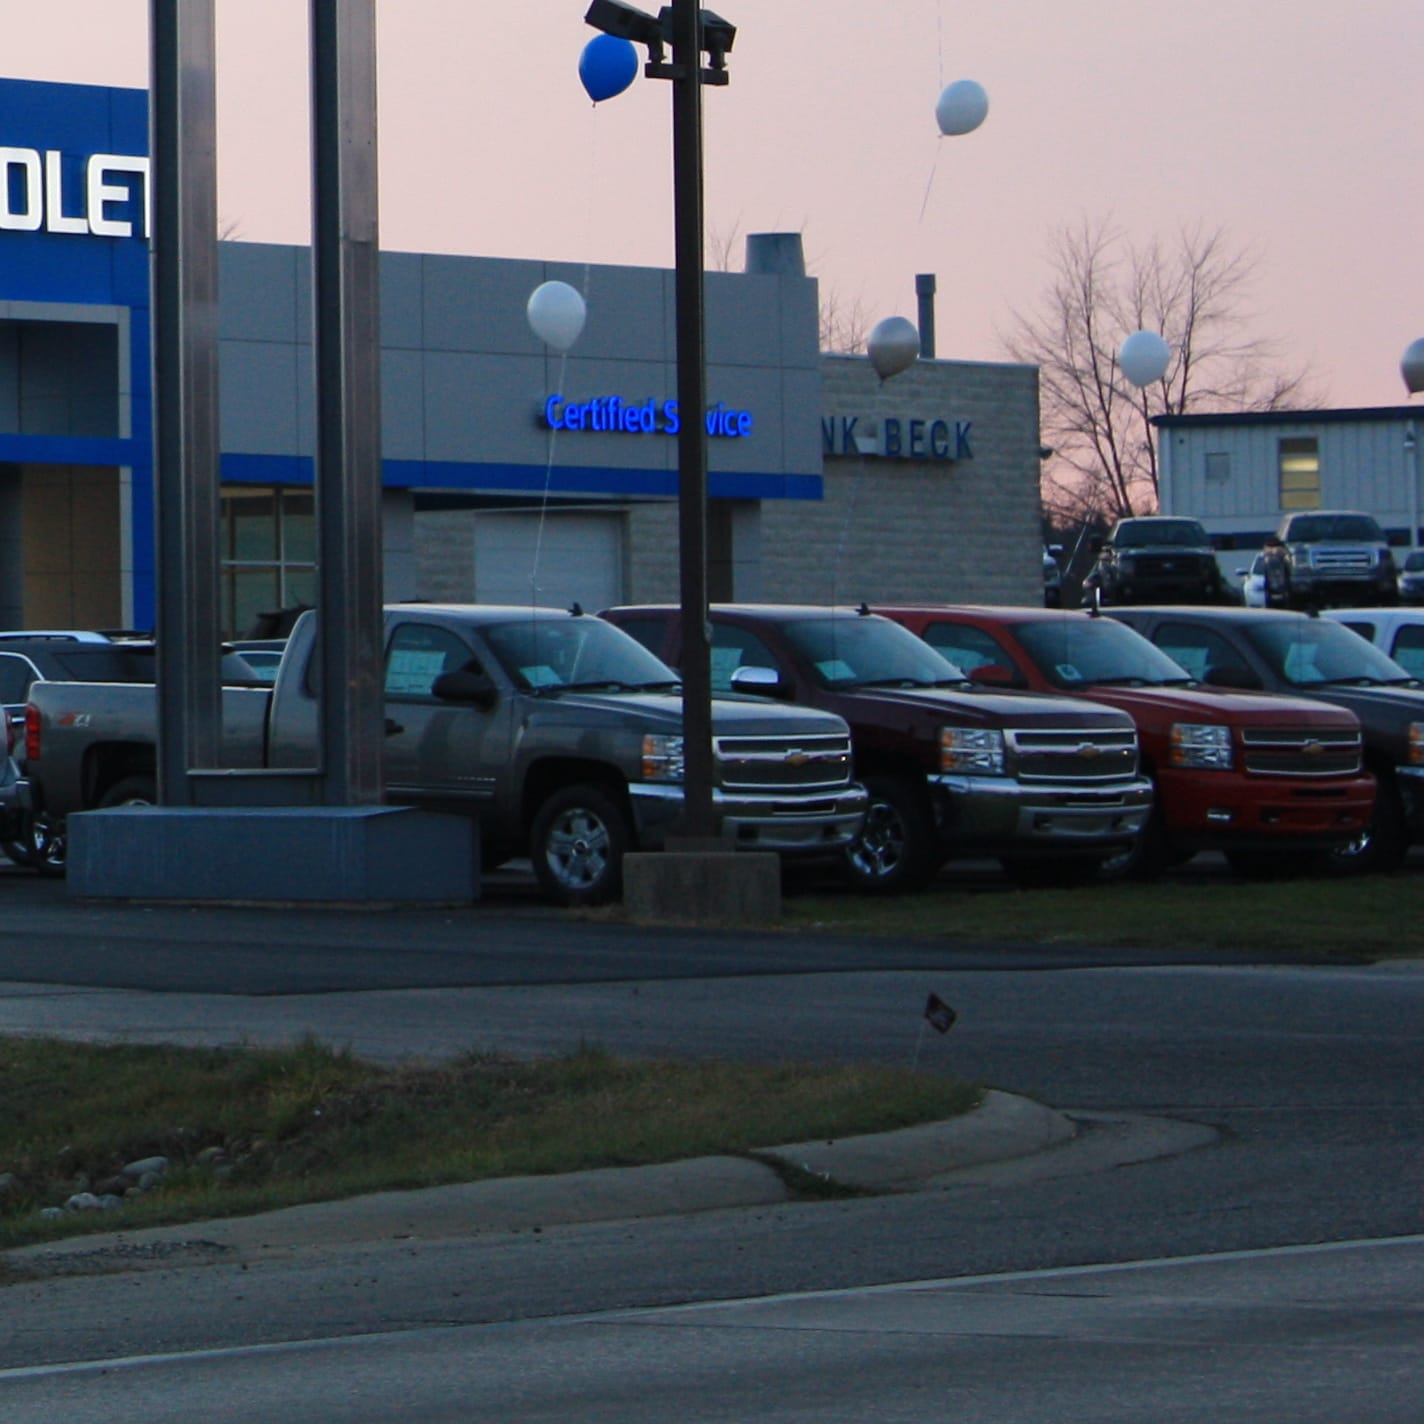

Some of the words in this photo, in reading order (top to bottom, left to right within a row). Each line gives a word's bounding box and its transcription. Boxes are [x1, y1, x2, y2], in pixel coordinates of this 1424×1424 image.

[545, 394, 656, 433] Certified
[662, 399, 753, 438] Svice
[883, 418, 974, 460] BECK
